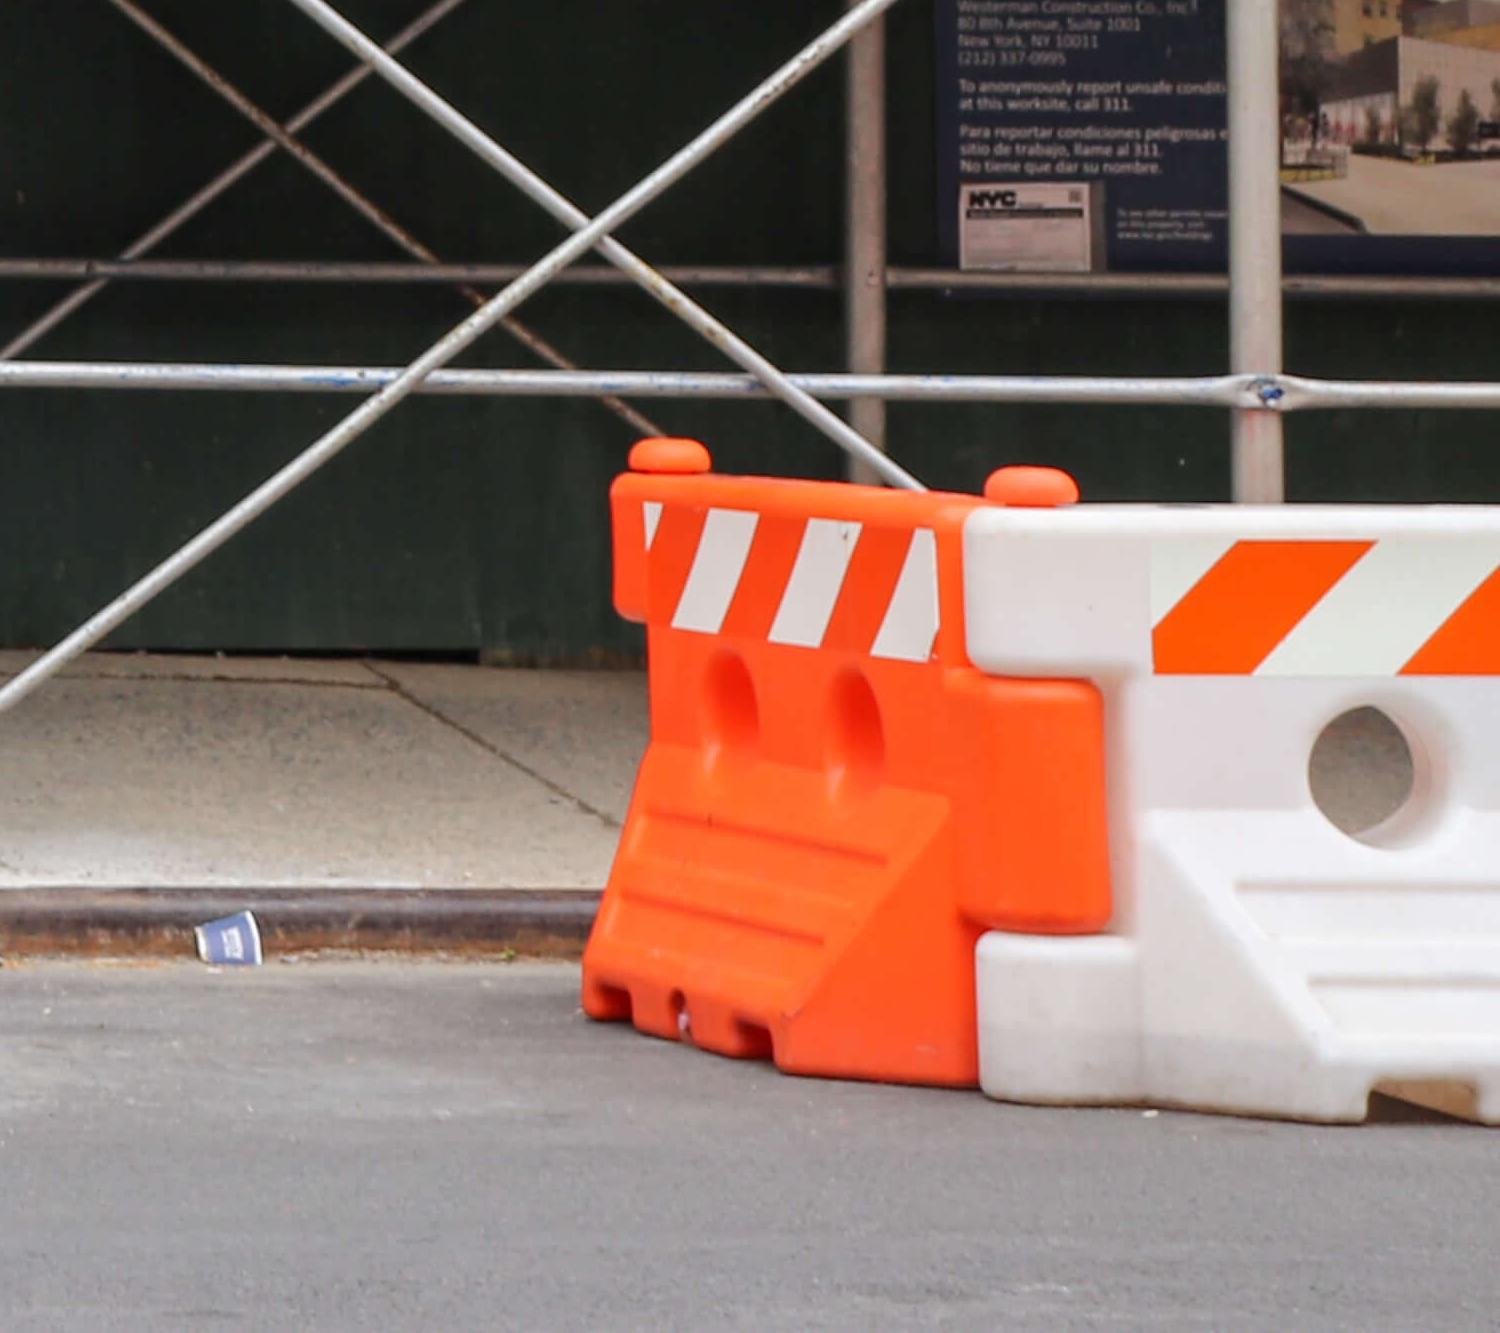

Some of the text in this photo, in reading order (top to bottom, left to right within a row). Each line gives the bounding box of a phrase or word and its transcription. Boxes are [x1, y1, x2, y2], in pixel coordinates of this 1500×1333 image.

[1041, 0, 1132, 15] Construction
[1066, 18, 1104, 32] Suite
[958, 34, 990, 48] New
[959, 79, 976, 94] To
[978, 80, 1074, 97] anonymously
[1076, 80, 1122, 97] report
[1125, 79, 1173, 94] unsafe
[959, 97, 974, 112] at
[976, 97, 1004, 112] this
[1007, 97, 1072, 114] worksite,
[1075, 97, 1101, 112] call
[959, 125, 991, 140] Para
[994, 125, 1055, 144] reportar
[1056, 124, 1141, 140] condiciones
[1145, 124, 1217, 143] peligrosas
[959, 143, 990, 157] sitio
[993, 143, 1013, 157] de
[1015, 142, 1071, 161] trabajo,
[1073, 142, 1113, 157] llame
[1116, 142, 1131, 157] al
[960, 159, 1164, 177] No tiene que dar su nombre.
[970, 190, 1017, 207] NYC
